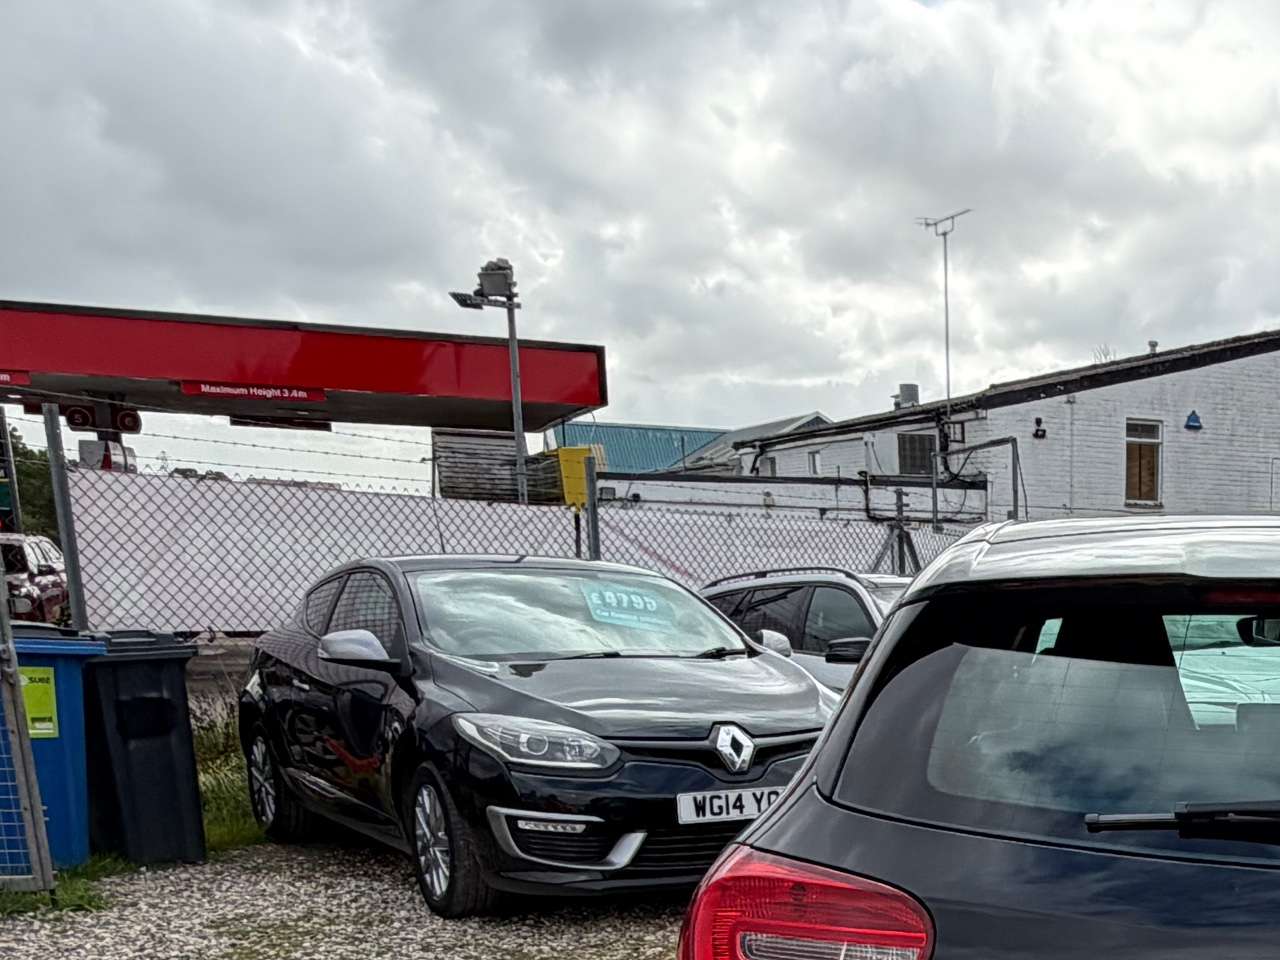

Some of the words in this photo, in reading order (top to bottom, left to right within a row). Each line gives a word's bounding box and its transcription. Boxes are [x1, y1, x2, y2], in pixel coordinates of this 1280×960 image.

[200, 384, 248, 395] Maximum
[249, 387, 281, 398] Height
[692, 793, 745, 818] WG14
